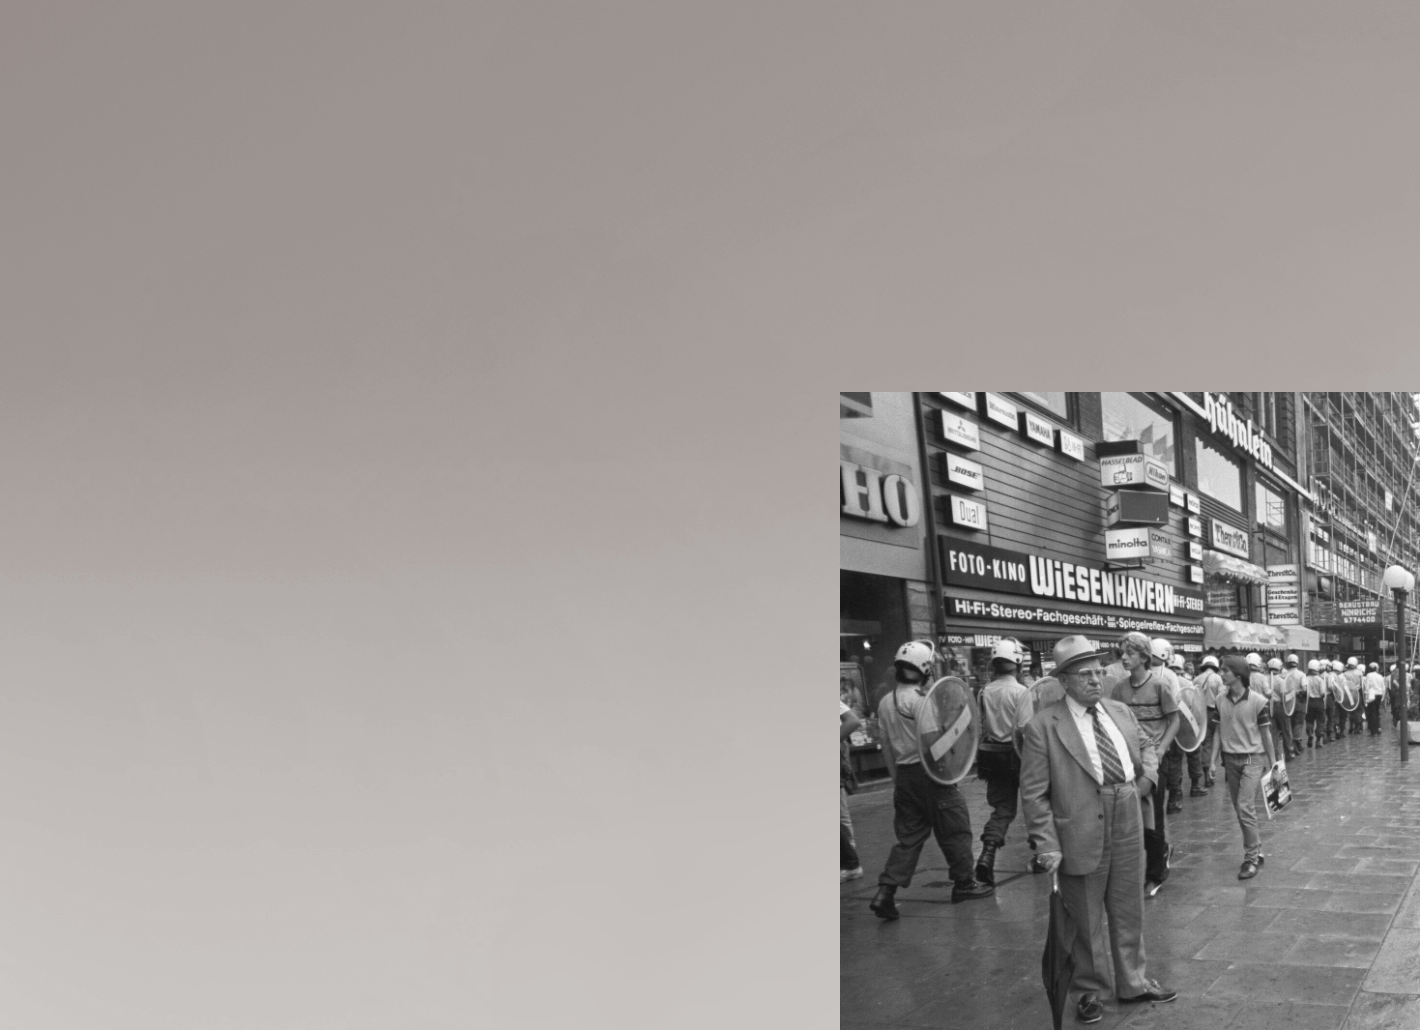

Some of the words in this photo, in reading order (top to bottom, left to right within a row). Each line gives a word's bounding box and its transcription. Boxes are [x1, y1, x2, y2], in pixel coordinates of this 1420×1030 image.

[1029, 419, 1051, 440] YAMAHA
[1101, 456, 1143, 466] HASSELBLAD
[950, 465, 981, 480] BOSE
[1148, 466, 1167, 481] Nikon
[959, 500, 980, 525] Dual
[1108, 537, 1148, 550] minolta
[1341, 608, 1377, 616] HINRICHS
